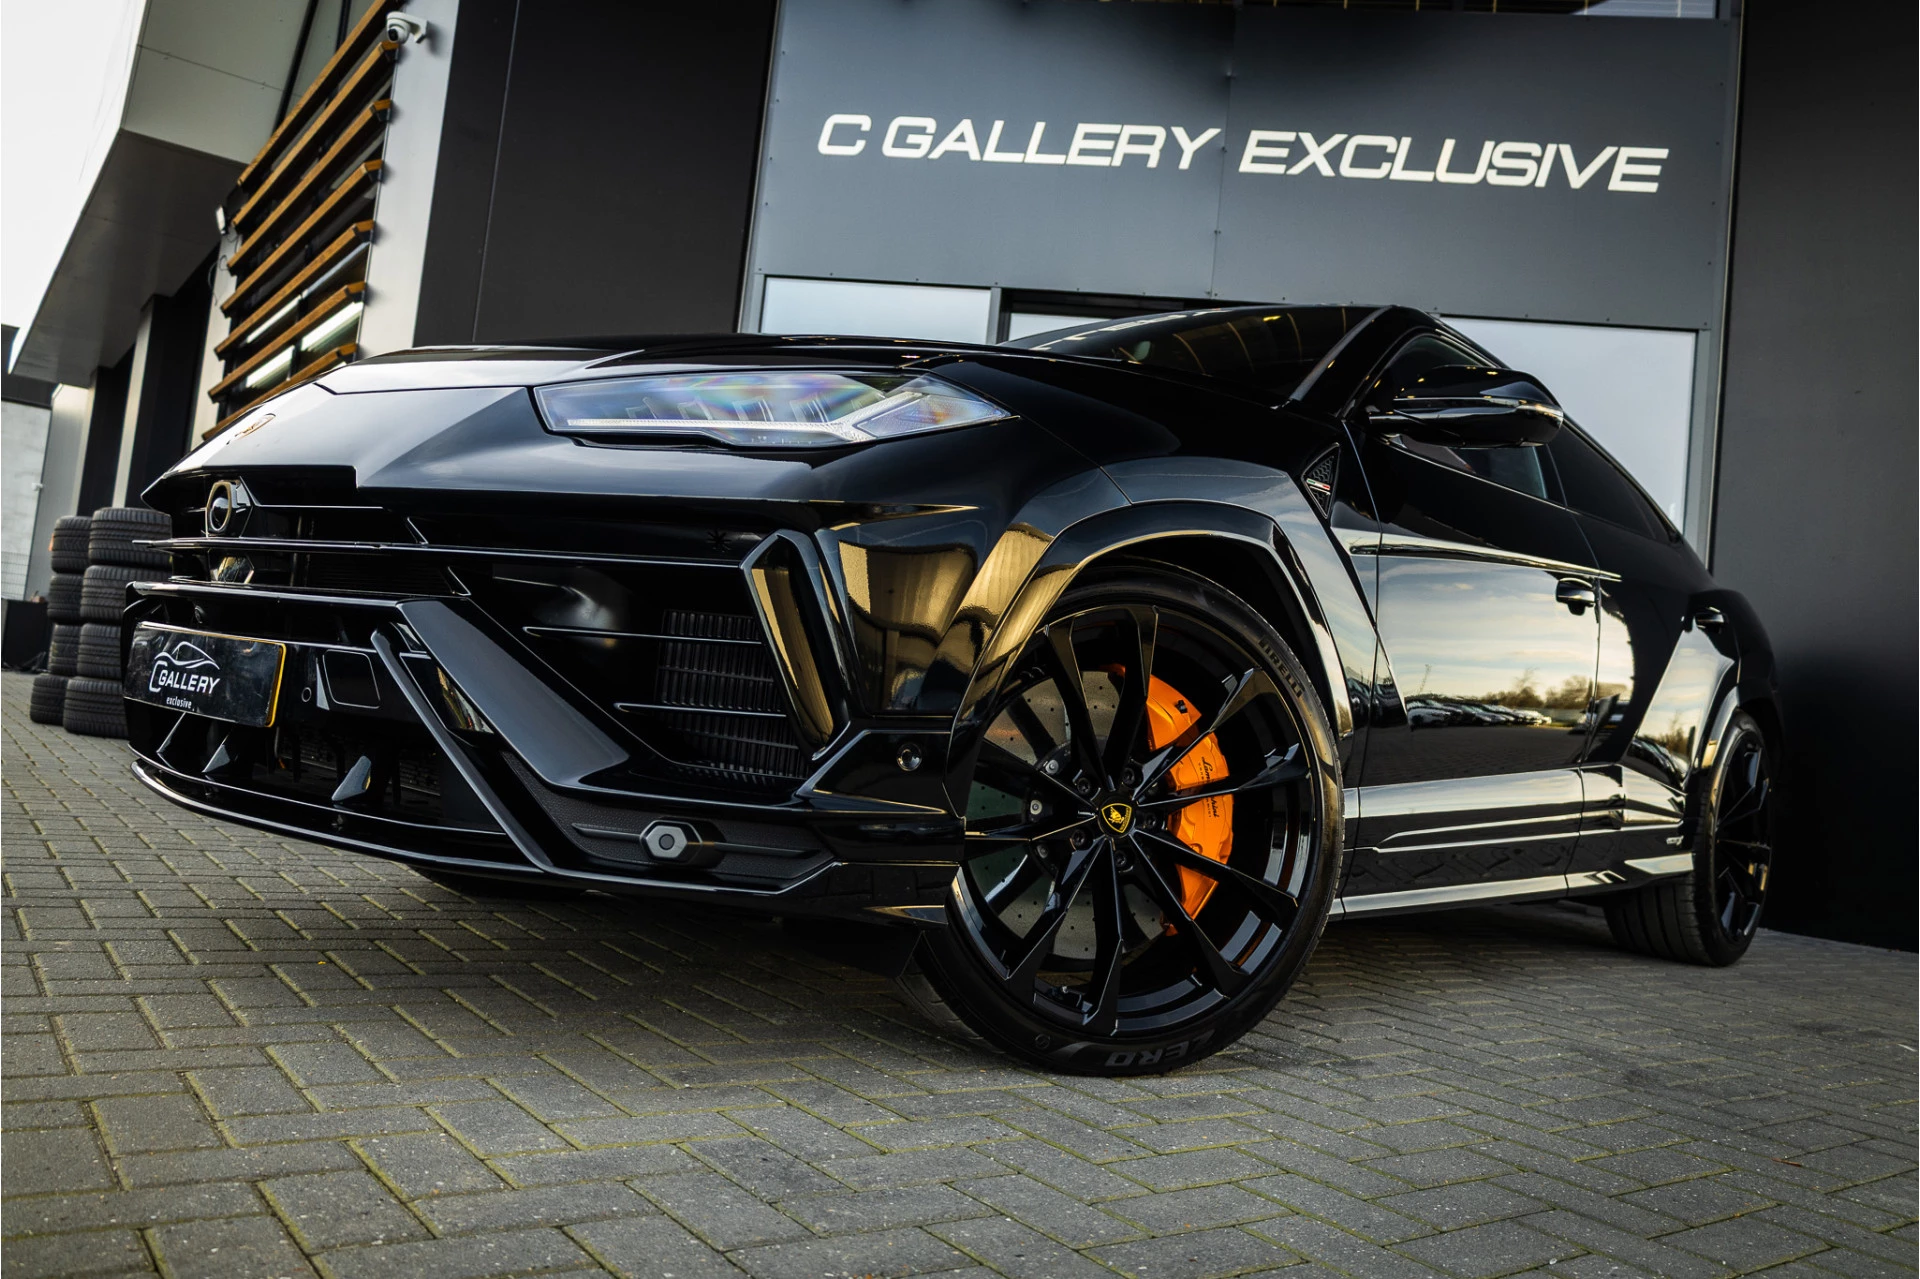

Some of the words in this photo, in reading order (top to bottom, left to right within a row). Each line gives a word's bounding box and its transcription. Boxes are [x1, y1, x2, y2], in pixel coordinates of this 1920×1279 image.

[817, 113, 872, 156] C
[881, 116, 1222, 170] GALLERY
[1238, 129, 1670, 193] EXCLUSIVE
[158, 669, 221, 695] GALLERY
[1258, 636, 1305, 698] PIRELLI
[166, 695, 192, 709] exclusive
[1104, 1029, 1216, 1068] ZERO
